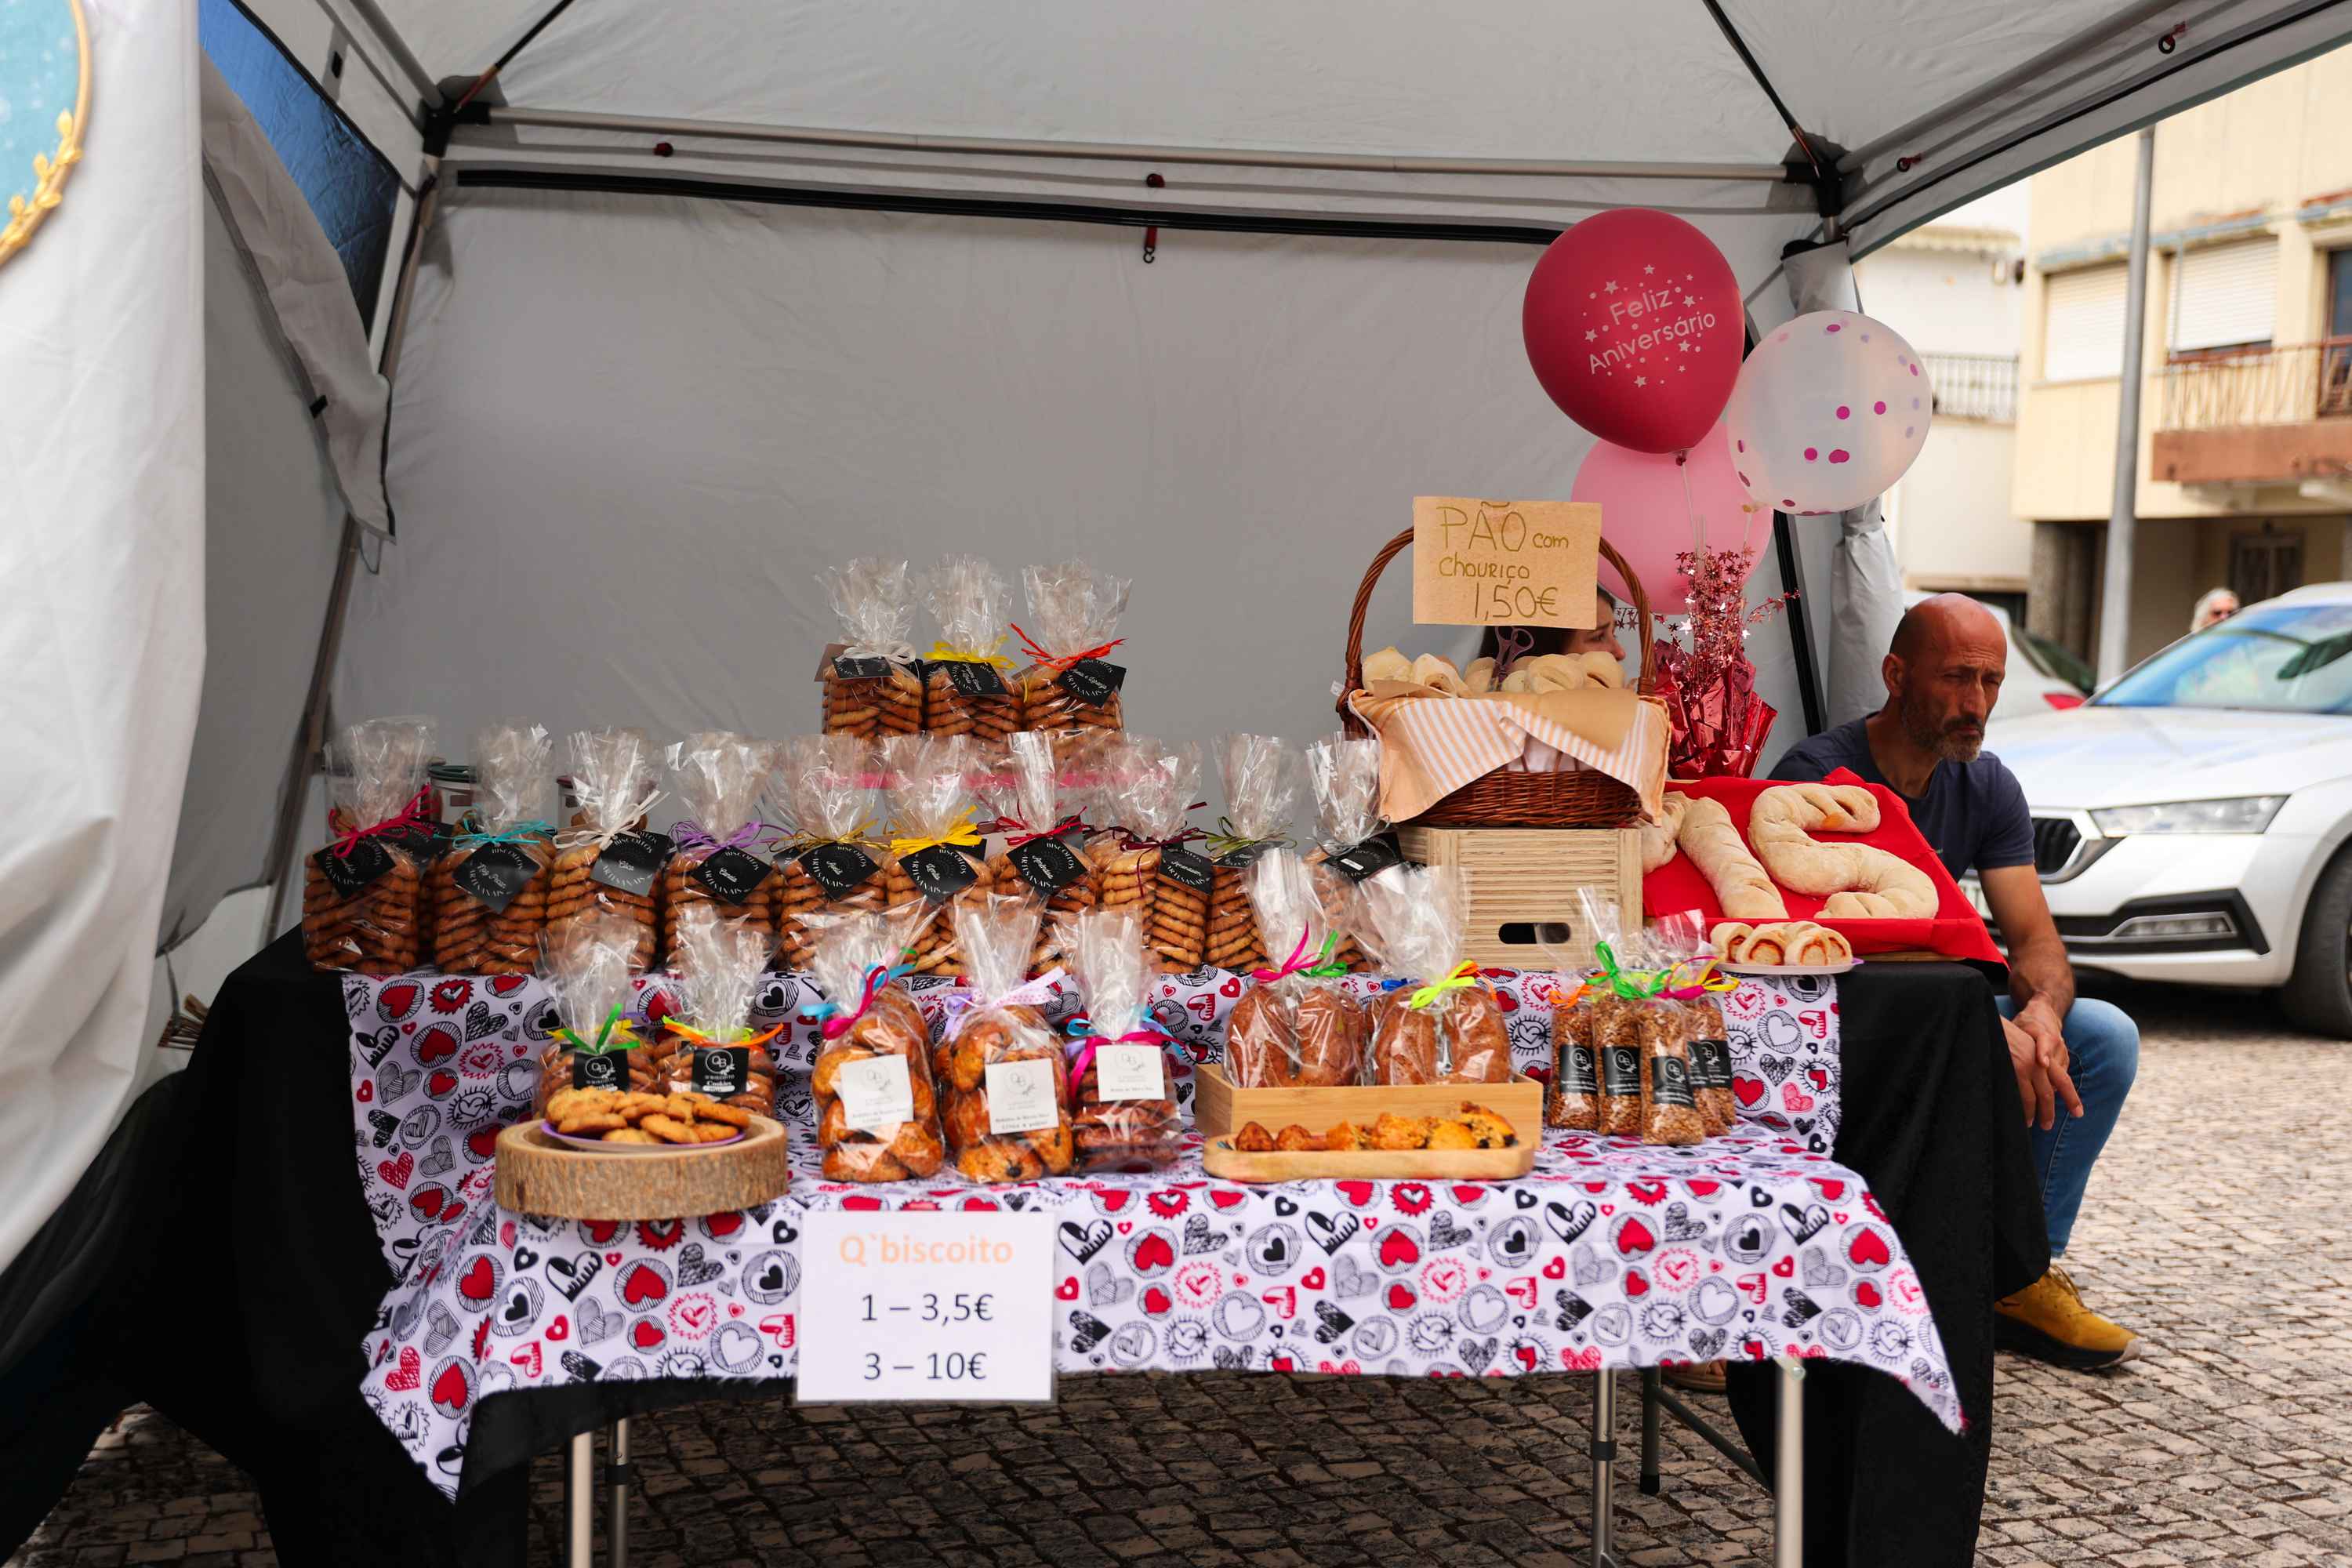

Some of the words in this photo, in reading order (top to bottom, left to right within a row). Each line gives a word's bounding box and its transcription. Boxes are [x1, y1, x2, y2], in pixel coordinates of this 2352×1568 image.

[1610, 289, 1673, 325] Feliz
[1589, 311, 1716, 375] Aniversário
[1436, 501, 1526, 552] PÃO
[1533, 532, 1569, 548] com
[1475, 582, 1559, 621] 1,50€
[861, 1294, 877, 1321] 1
[921, 1294, 993, 1327] 3,5€
[864, 1352, 881, 1380] 3
[927, 1352, 988, 1380] 10€
